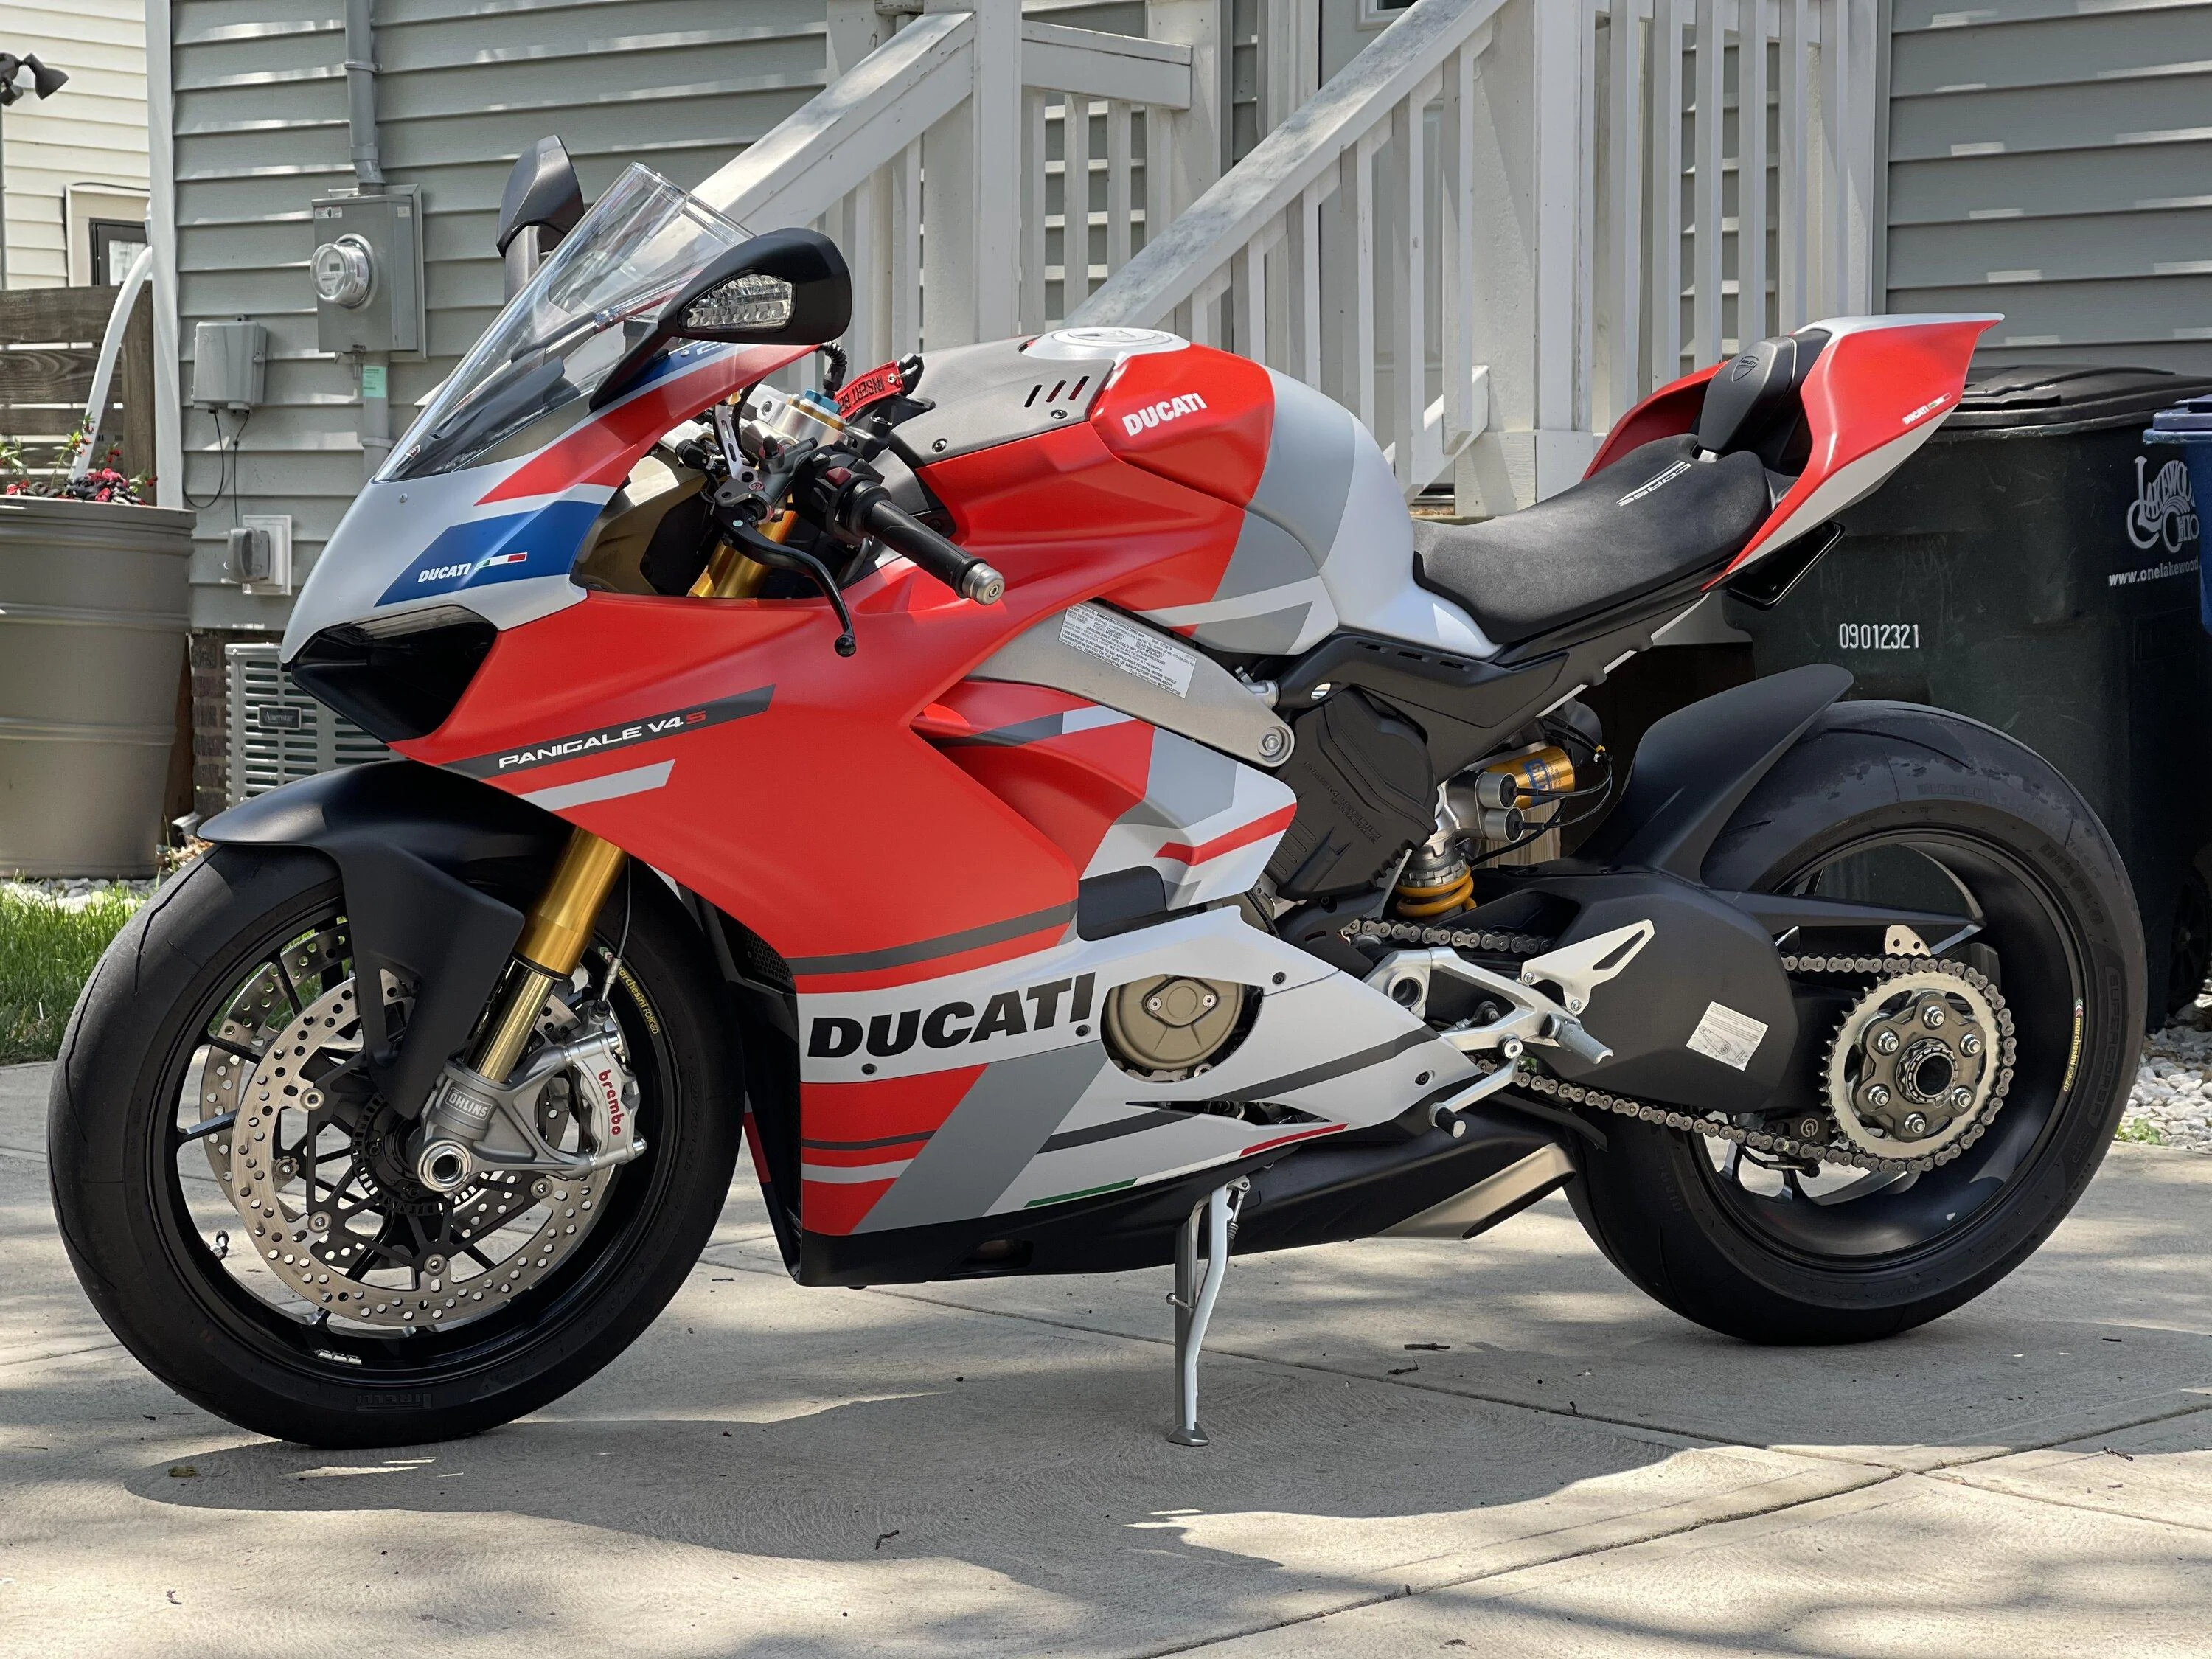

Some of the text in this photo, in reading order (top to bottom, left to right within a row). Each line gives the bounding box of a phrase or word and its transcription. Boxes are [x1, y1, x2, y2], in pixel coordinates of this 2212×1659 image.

[852, 375, 885, 404] INSERT
[1122, 393, 1207, 436] DUCATI
[1902, 405, 1930, 425] DUCATI
[2162, 514, 2199, 553] OHIO
[417, 563, 472, 583] DUCATI
[1840, 623, 1919, 649] 09012321
[499, 726, 642, 768] PANIGALE
[619, 967, 659, 1034] archesini FORGED
[807, 972, 1096, 1058] DUCATI
[2063, 1018, 2081, 1091] marchesini FORGED
[448, 1090, 488, 1117] ÖHLINS
[598, 1069, 625, 1135] brembo
[357, 1392, 432, 1411] PIRELLI
